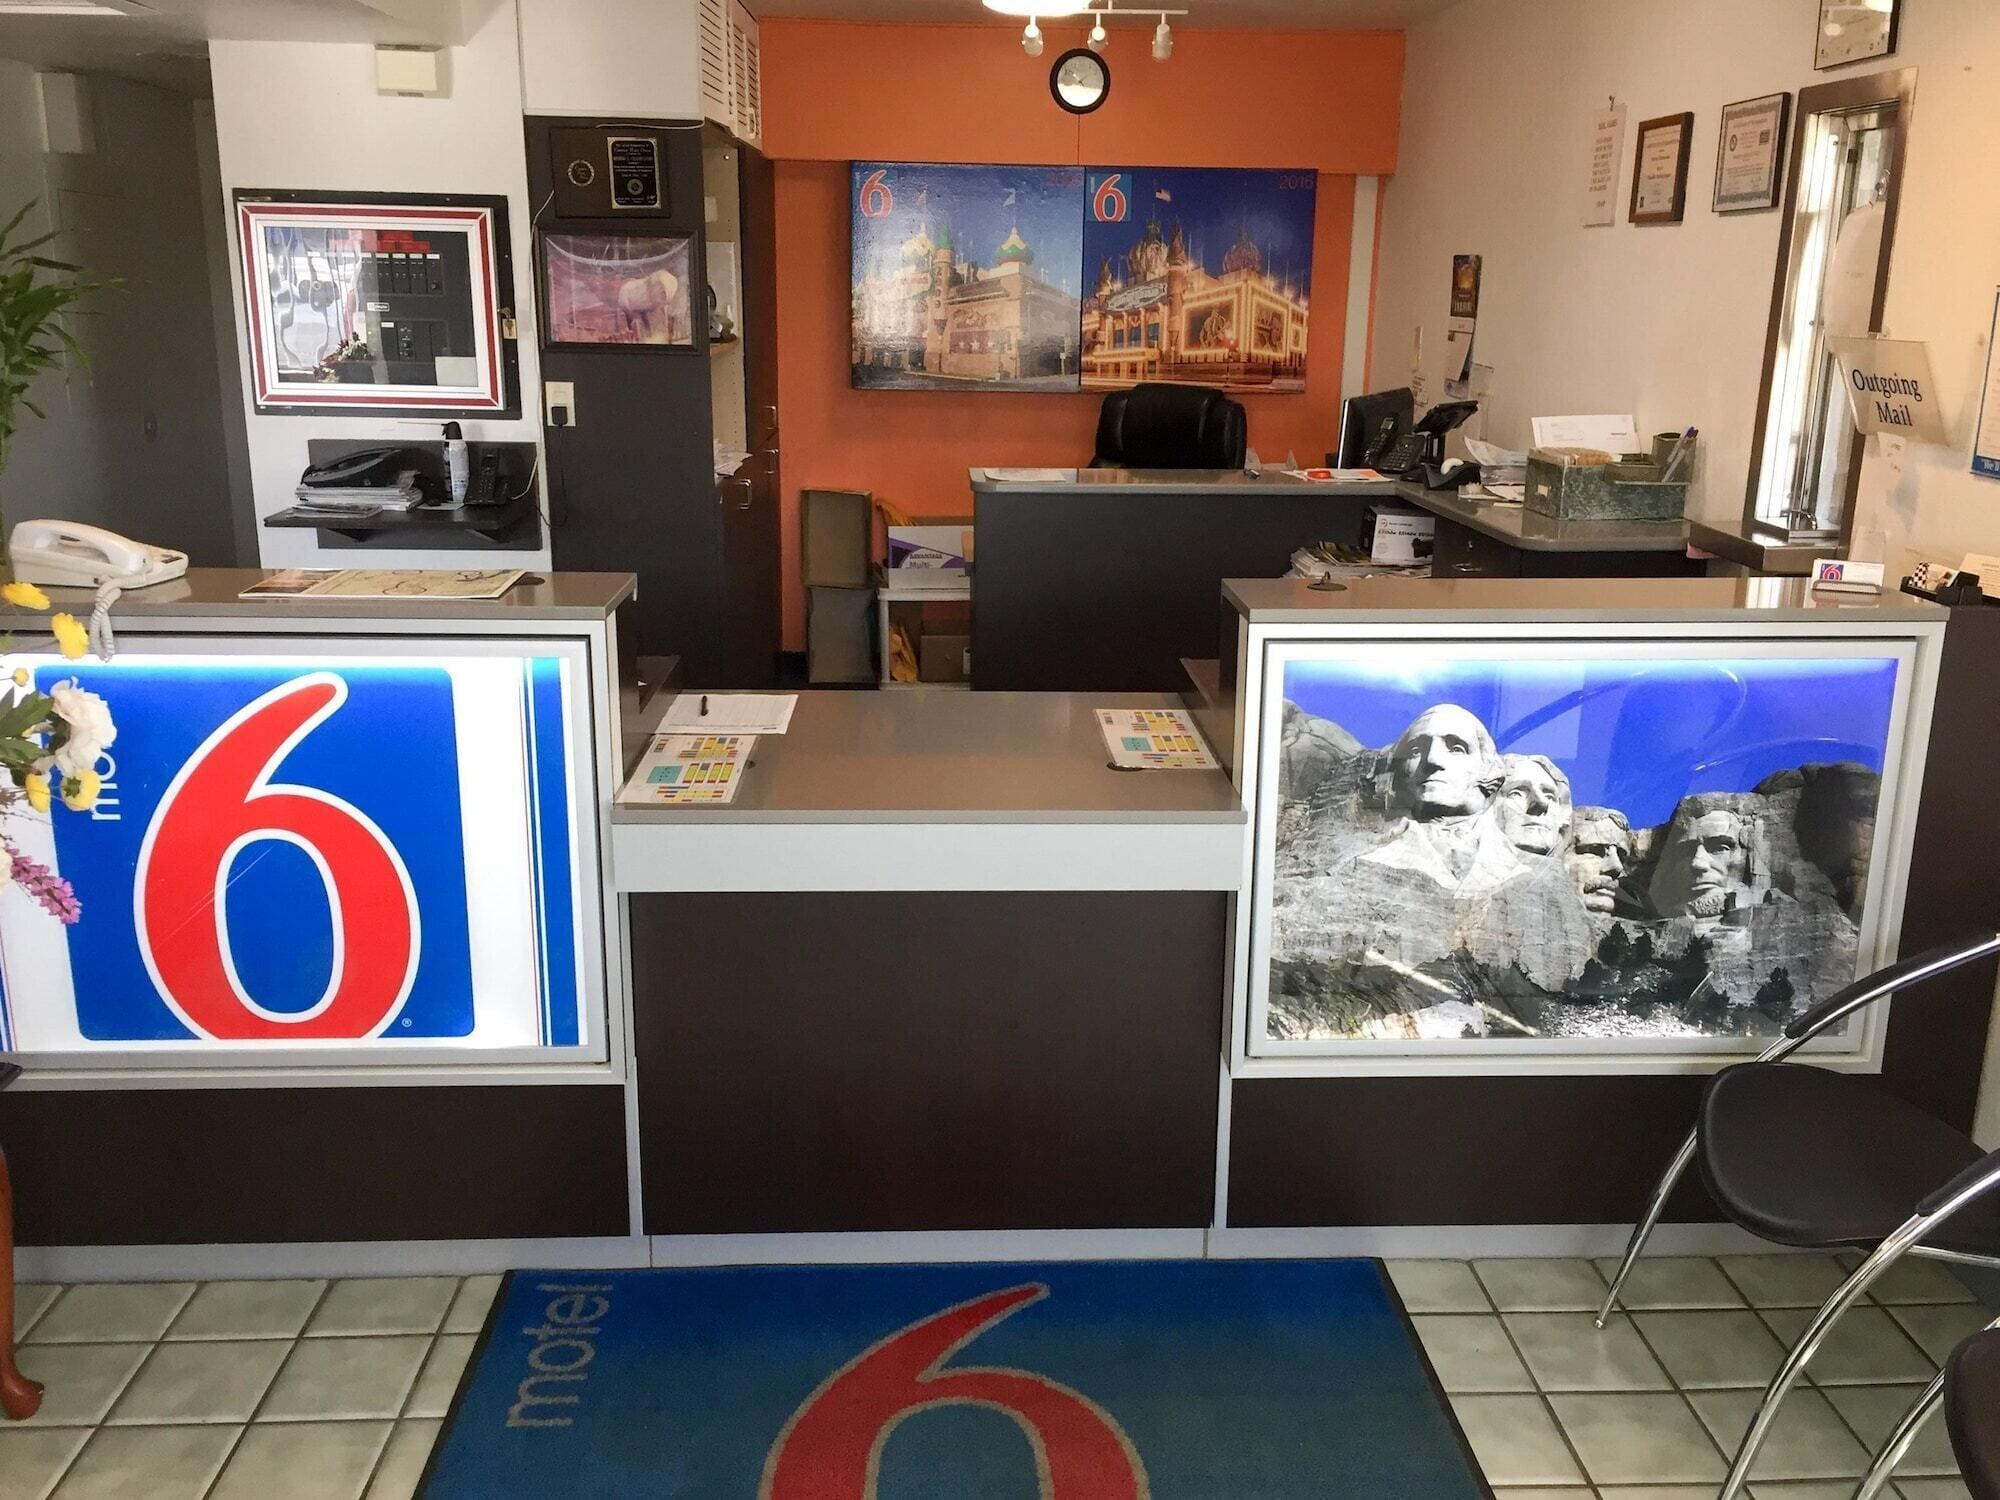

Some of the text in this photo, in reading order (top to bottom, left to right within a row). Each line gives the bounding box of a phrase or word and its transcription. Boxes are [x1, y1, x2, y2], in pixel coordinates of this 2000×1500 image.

[860, 169, 893, 218] 6
[1093, 173, 1127, 223] 6
[1852, 369, 1923, 402] Outgoing
[1875, 401, 1913, 427] Mail
[133, 671, 422, 1041] 6
[505, 1283, 614, 1428] motel
[756, 1281, 1151, 1500] 6
